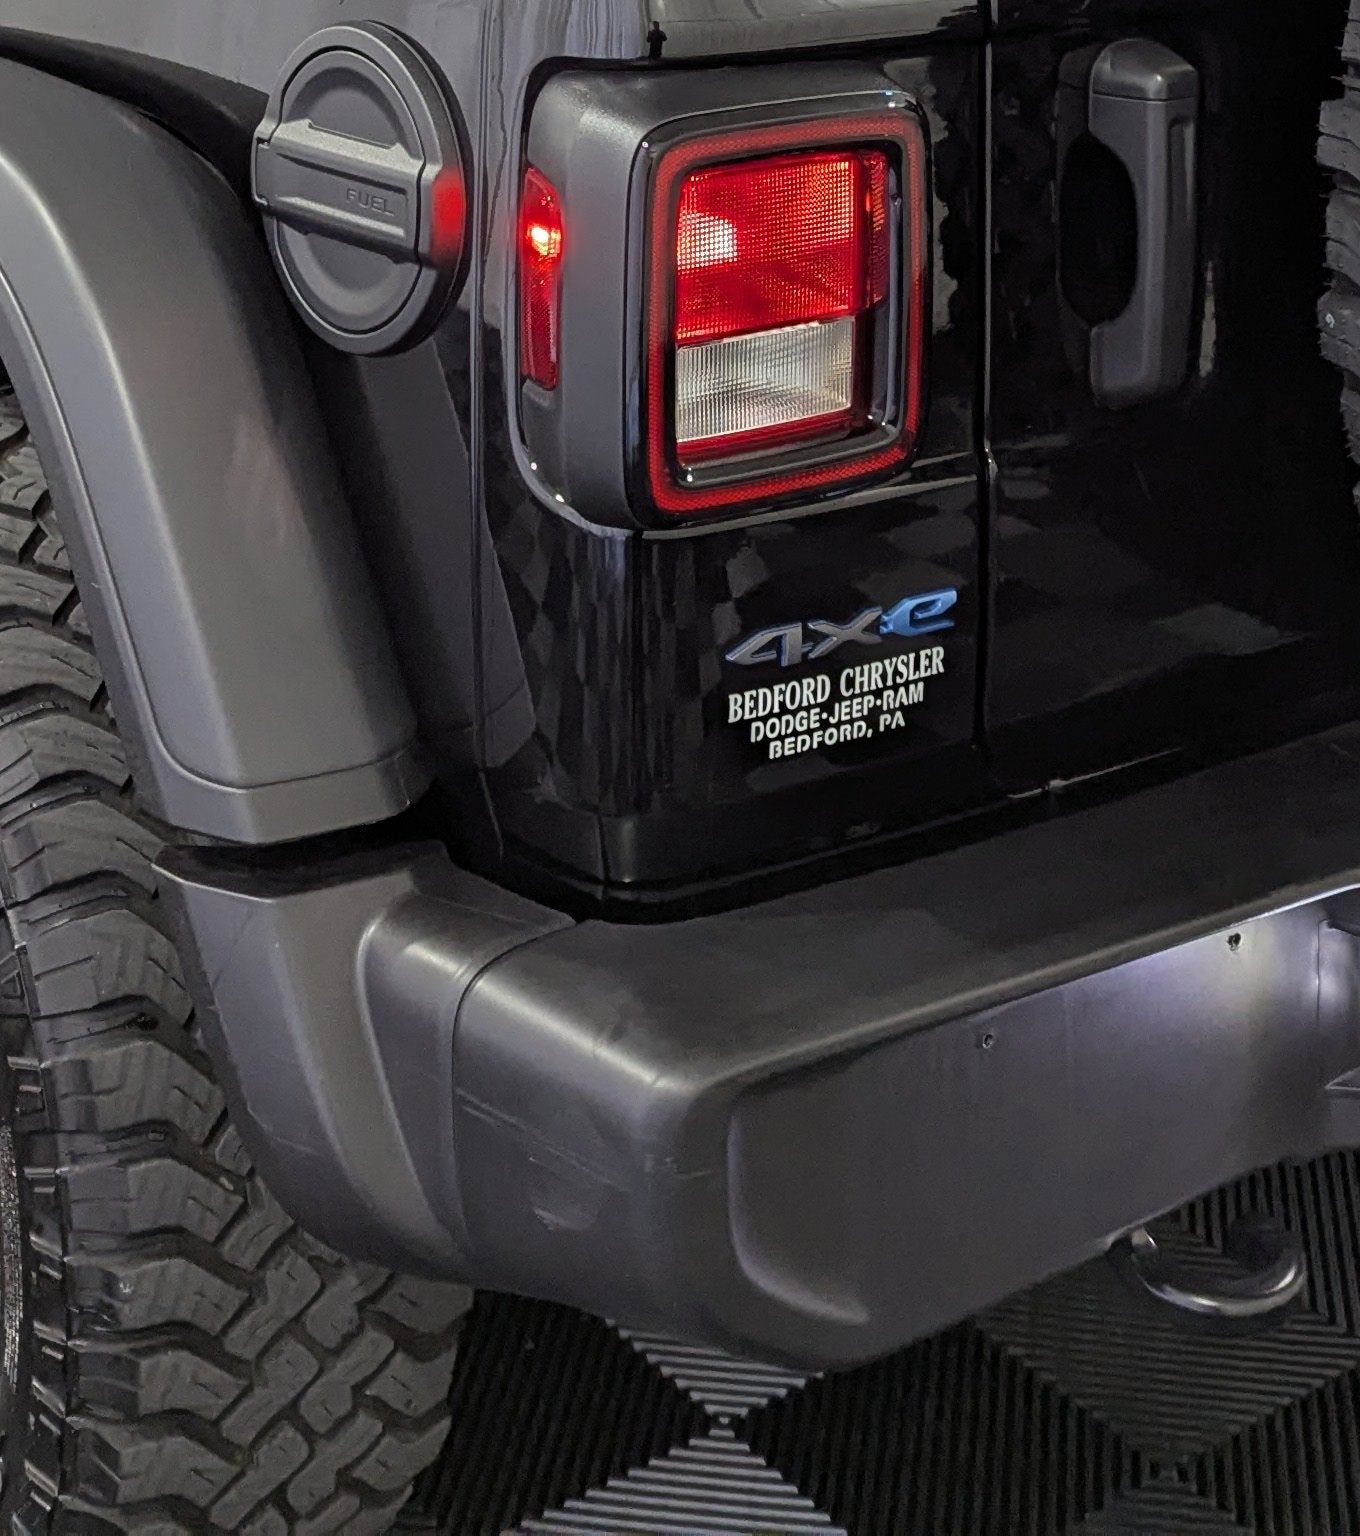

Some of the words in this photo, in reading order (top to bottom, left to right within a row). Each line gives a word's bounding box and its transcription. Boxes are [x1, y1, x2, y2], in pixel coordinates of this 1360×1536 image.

[346, 187, 396, 216] FUEL
[727, 674, 831, 724] BEDFORD
[839, 645, 945, 698] CHRYSLER
[768, 719, 874, 760] BEDFORD,
[879, 710, 906, 732] PA
